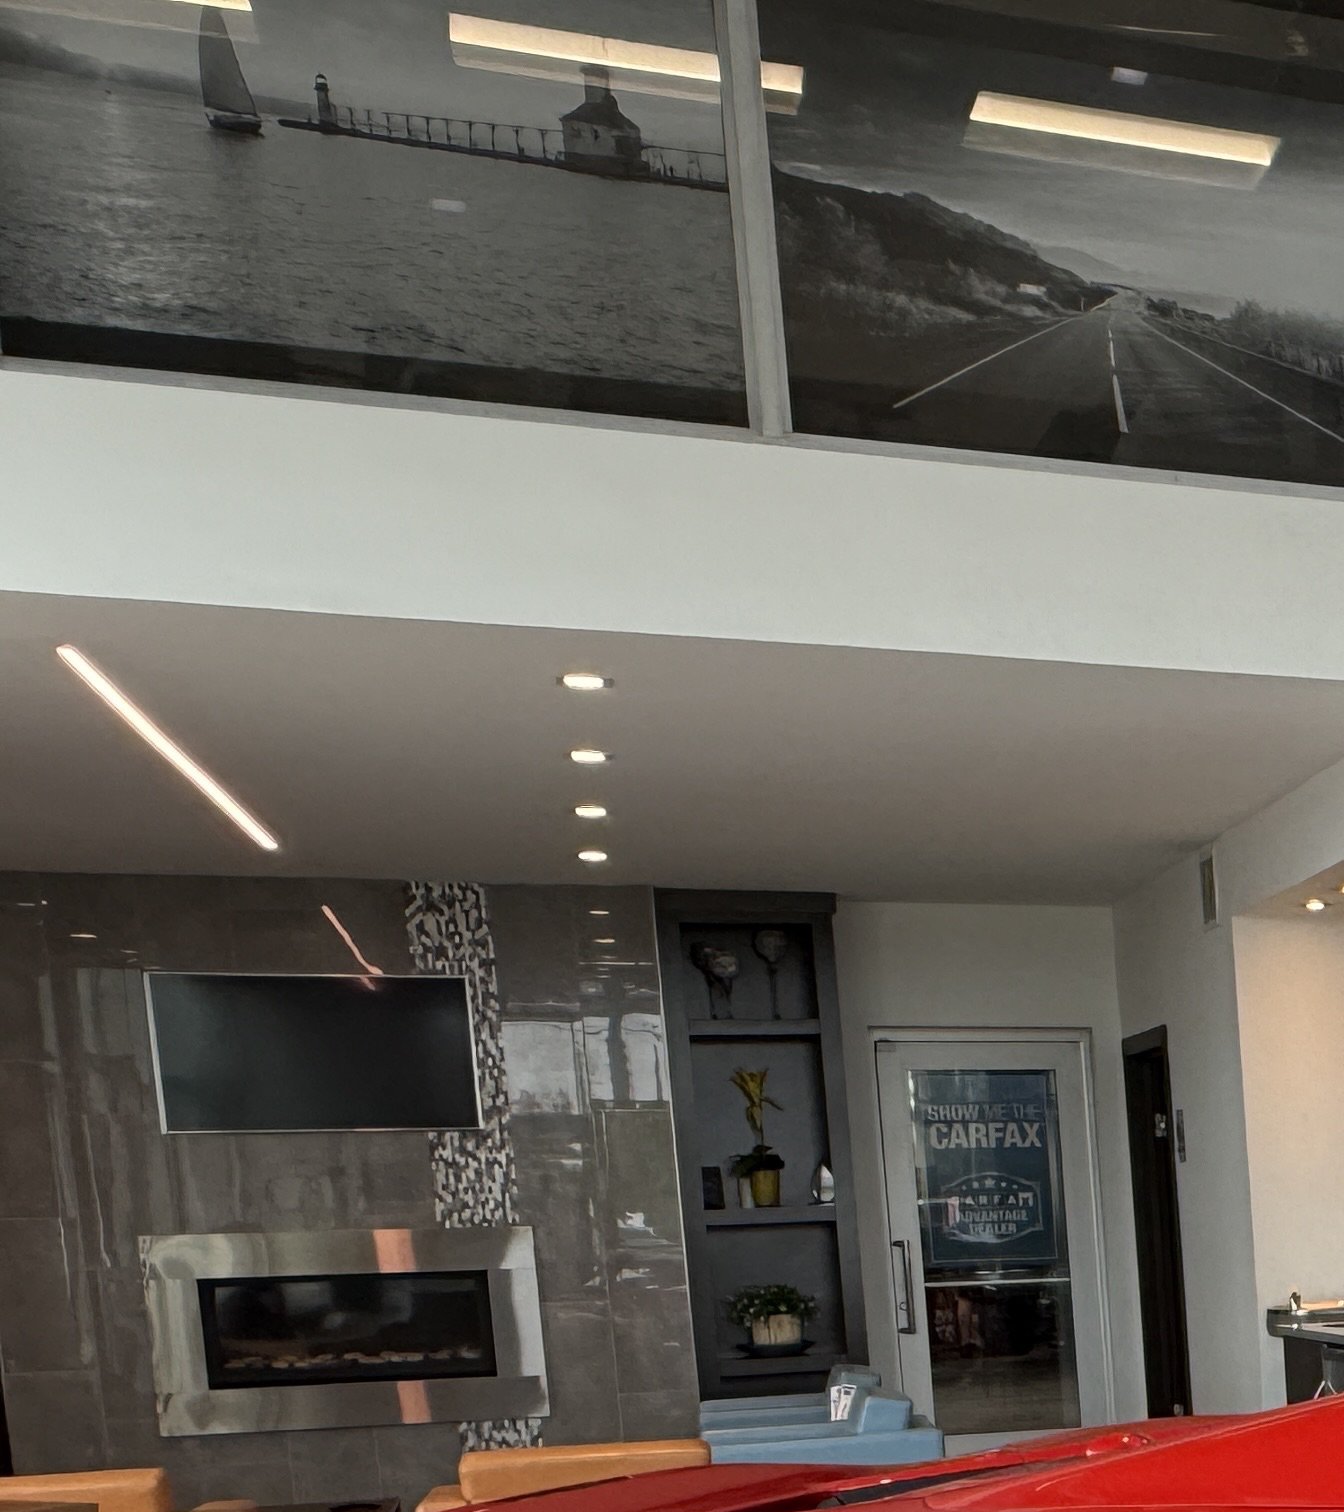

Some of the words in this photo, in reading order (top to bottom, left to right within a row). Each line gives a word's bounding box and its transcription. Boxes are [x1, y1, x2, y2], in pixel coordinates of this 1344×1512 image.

[927, 1103, 979, 1121] SHOW
[985, 1103, 1007, 1120] ME
[1013, 1103, 1041, 1120] THE
[929, 1121, 1043, 1149] CARFAX
[968, 1222, 1017, 1235] DEALER
